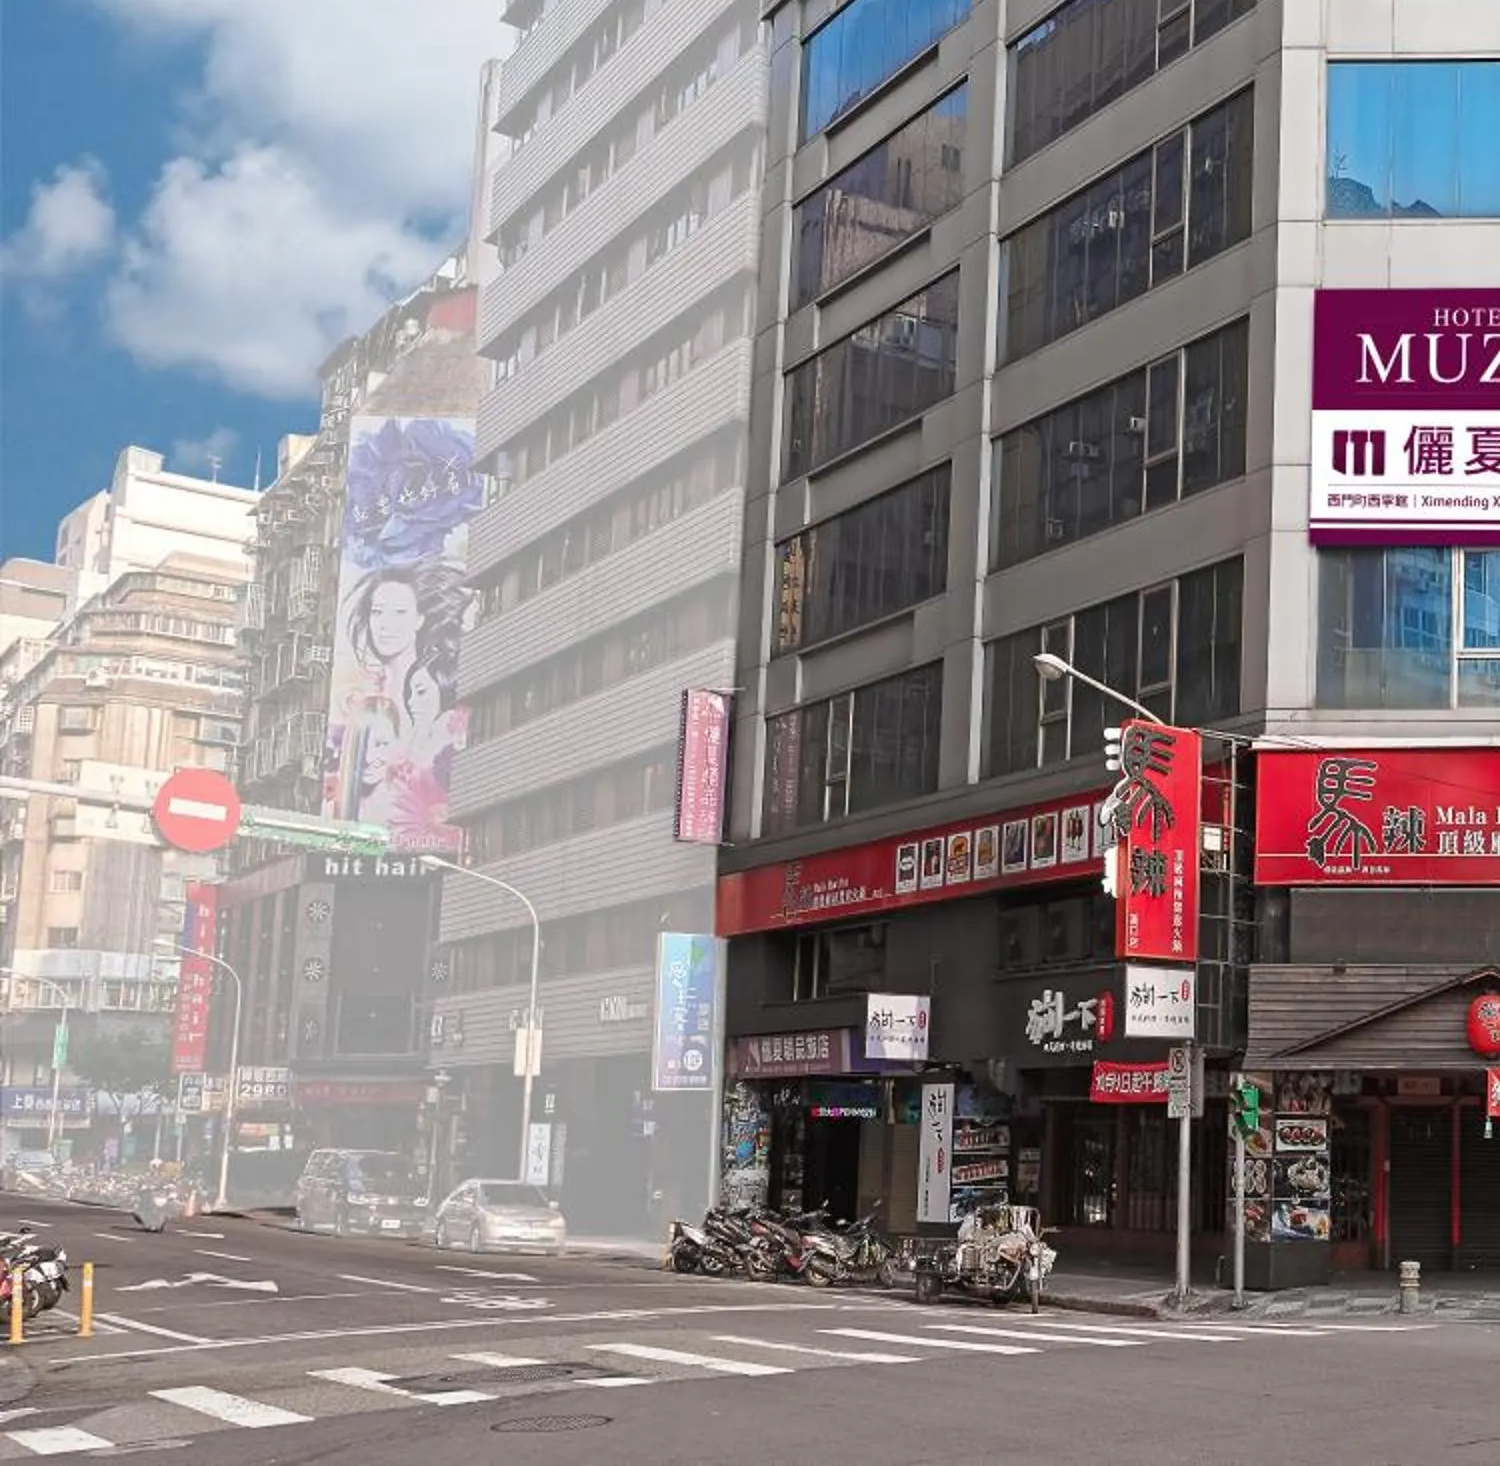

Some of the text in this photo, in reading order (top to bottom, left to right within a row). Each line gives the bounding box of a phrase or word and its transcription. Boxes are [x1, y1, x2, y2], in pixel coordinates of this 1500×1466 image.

[1421, 494, 1489, 510] Ximending
[1435, 807, 1486, 825] Mala
[325, 857, 364, 876] hit
